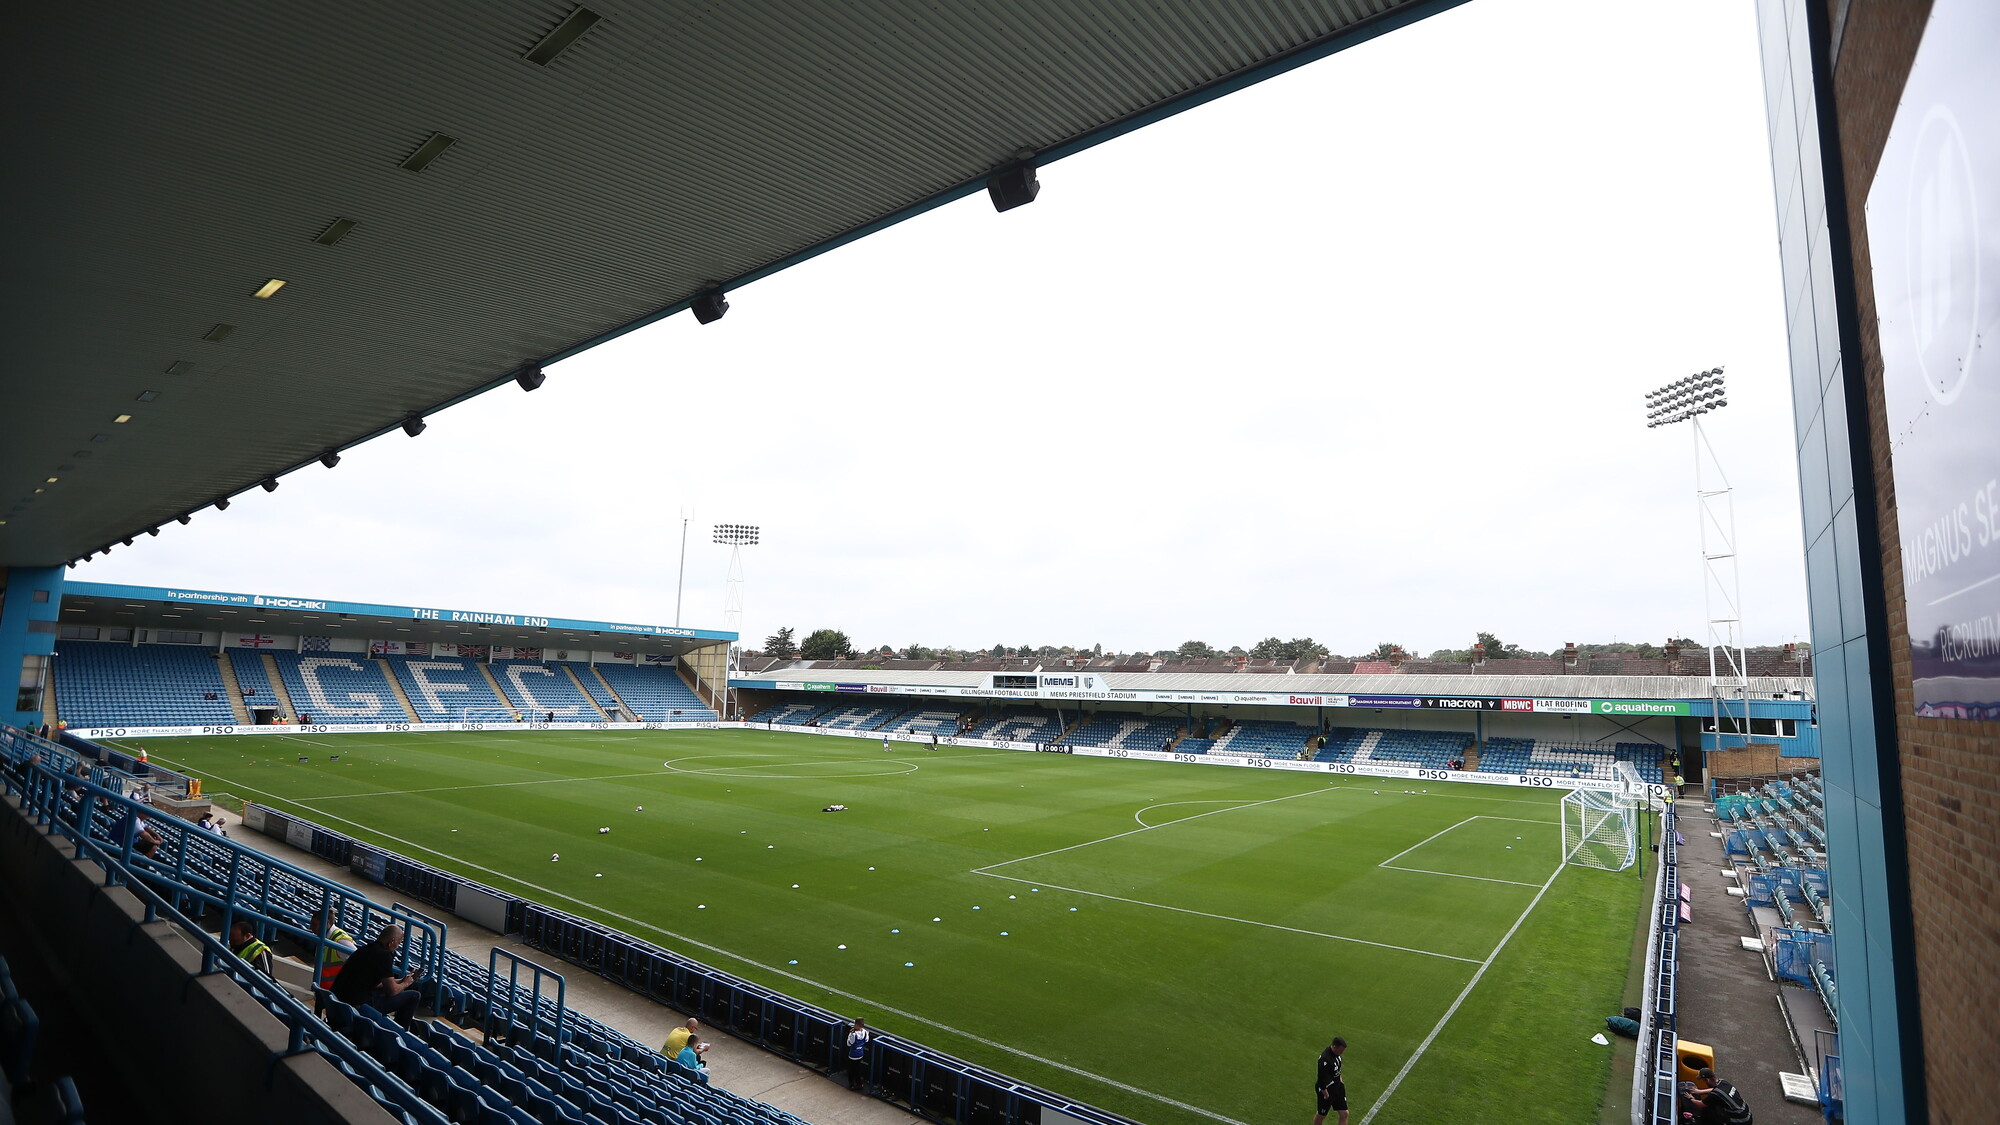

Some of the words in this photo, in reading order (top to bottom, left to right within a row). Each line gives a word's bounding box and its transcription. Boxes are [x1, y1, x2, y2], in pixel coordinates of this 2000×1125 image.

[1905, 502, 1972, 587] MAGNUS
[168, 590, 176, 598] In
[178, 592, 229, 602] partnership
[231, 595, 248, 603] with
[267, 599, 326, 610] HOCHIKI
[412, 608, 439, 620] THE
[452, 612, 516, 625] RAINHAM
[524, 617, 549, 627] END
[662, 628, 695, 636] HOCHIKI
[1289, 696, 1322, 705] Bauvill
[1439, 699, 1482, 708] macron
[1504, 700, 1531, 710] MBWC
[1615, 703, 1676, 712] aquatherm
[91, 728, 126, 737] PISO
[203, 726, 234, 735] PISO
[300, 725, 327, 733] PISO
[1109, 749, 1128, 758] PISO
[1174, 754, 1196, 762] PISO
[1248, 759, 1272, 768] PISO
[1329, 764, 1355, 773] PISO
[1419, 770, 1448, 780] PISO
[1520, 776, 1552, 787] PISO
